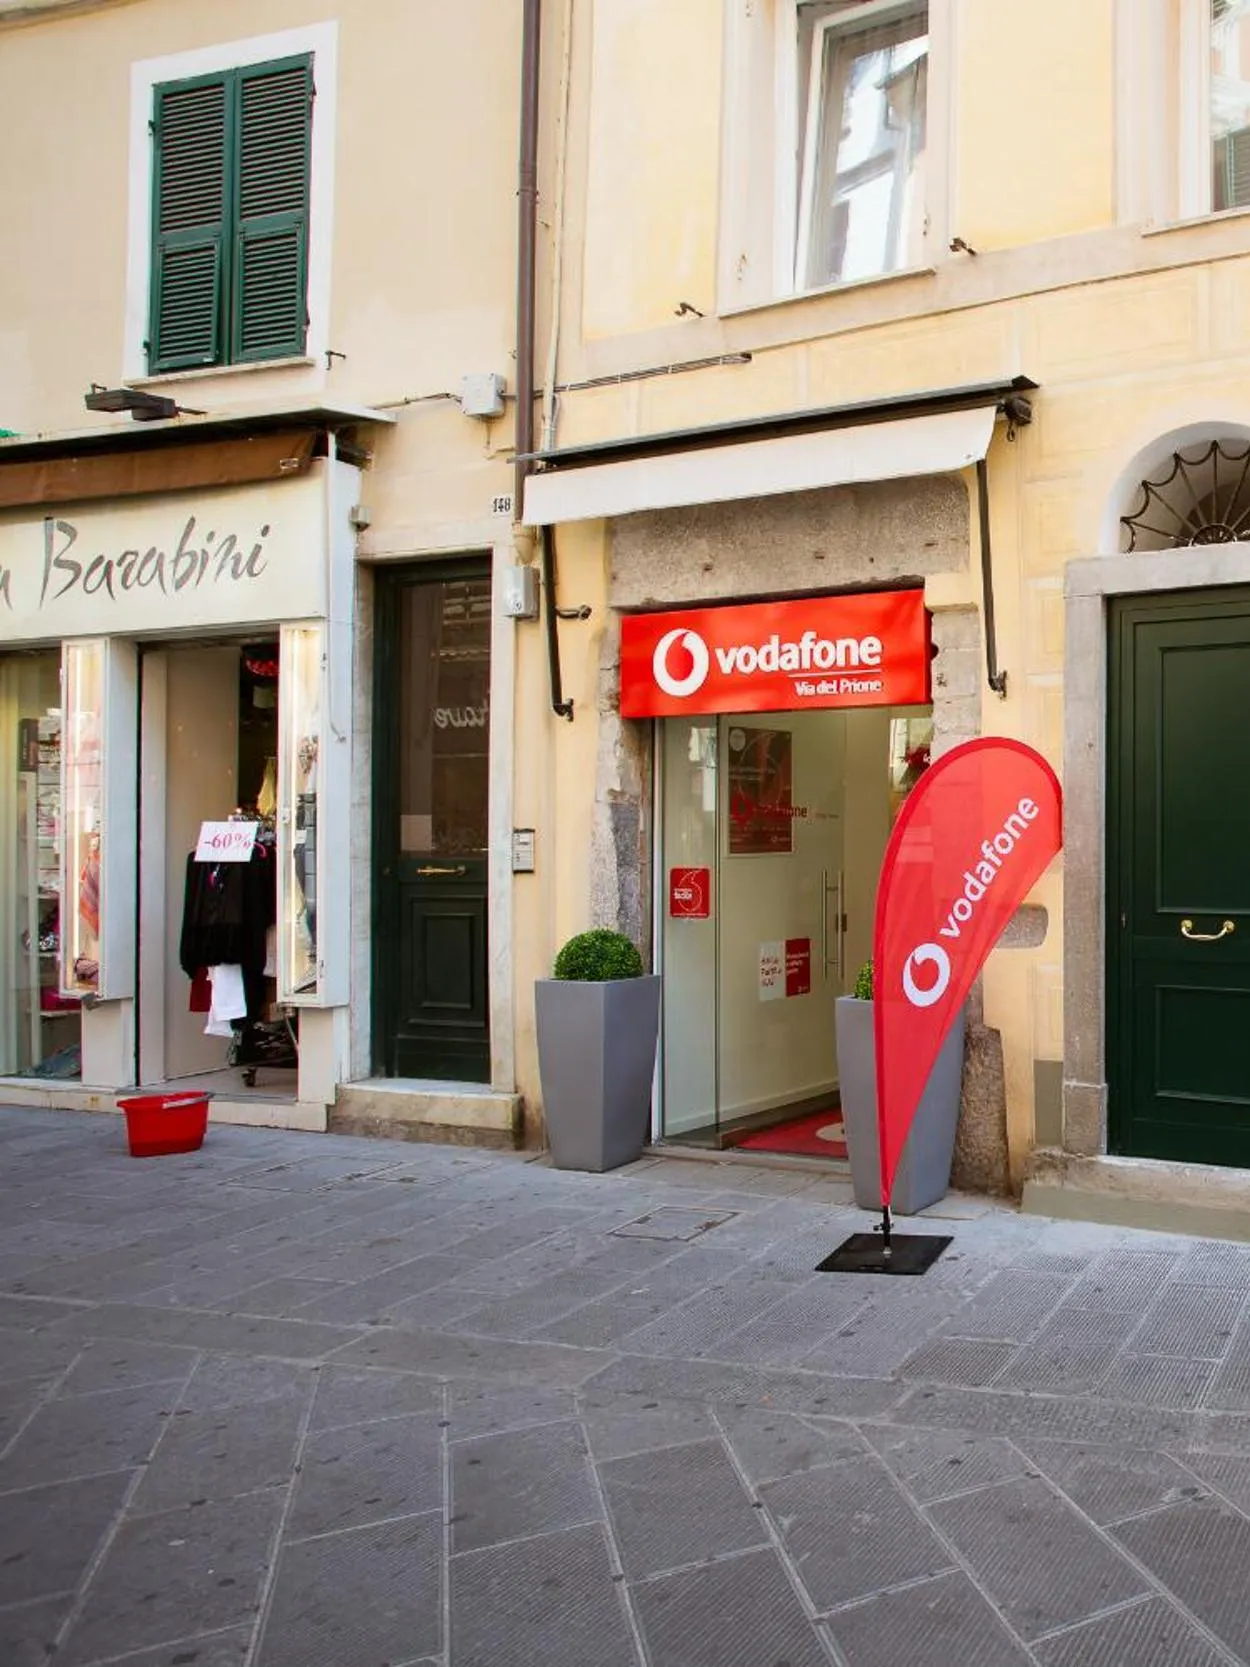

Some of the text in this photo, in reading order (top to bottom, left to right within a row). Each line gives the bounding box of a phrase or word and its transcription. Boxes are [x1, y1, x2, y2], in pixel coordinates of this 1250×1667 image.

[38, 515, 270, 610] Barabini
[715, 631, 882, 675] vodafone
[794, 678, 882, 697] Via del Prione
[939, 797, 1040, 938] vodafone
